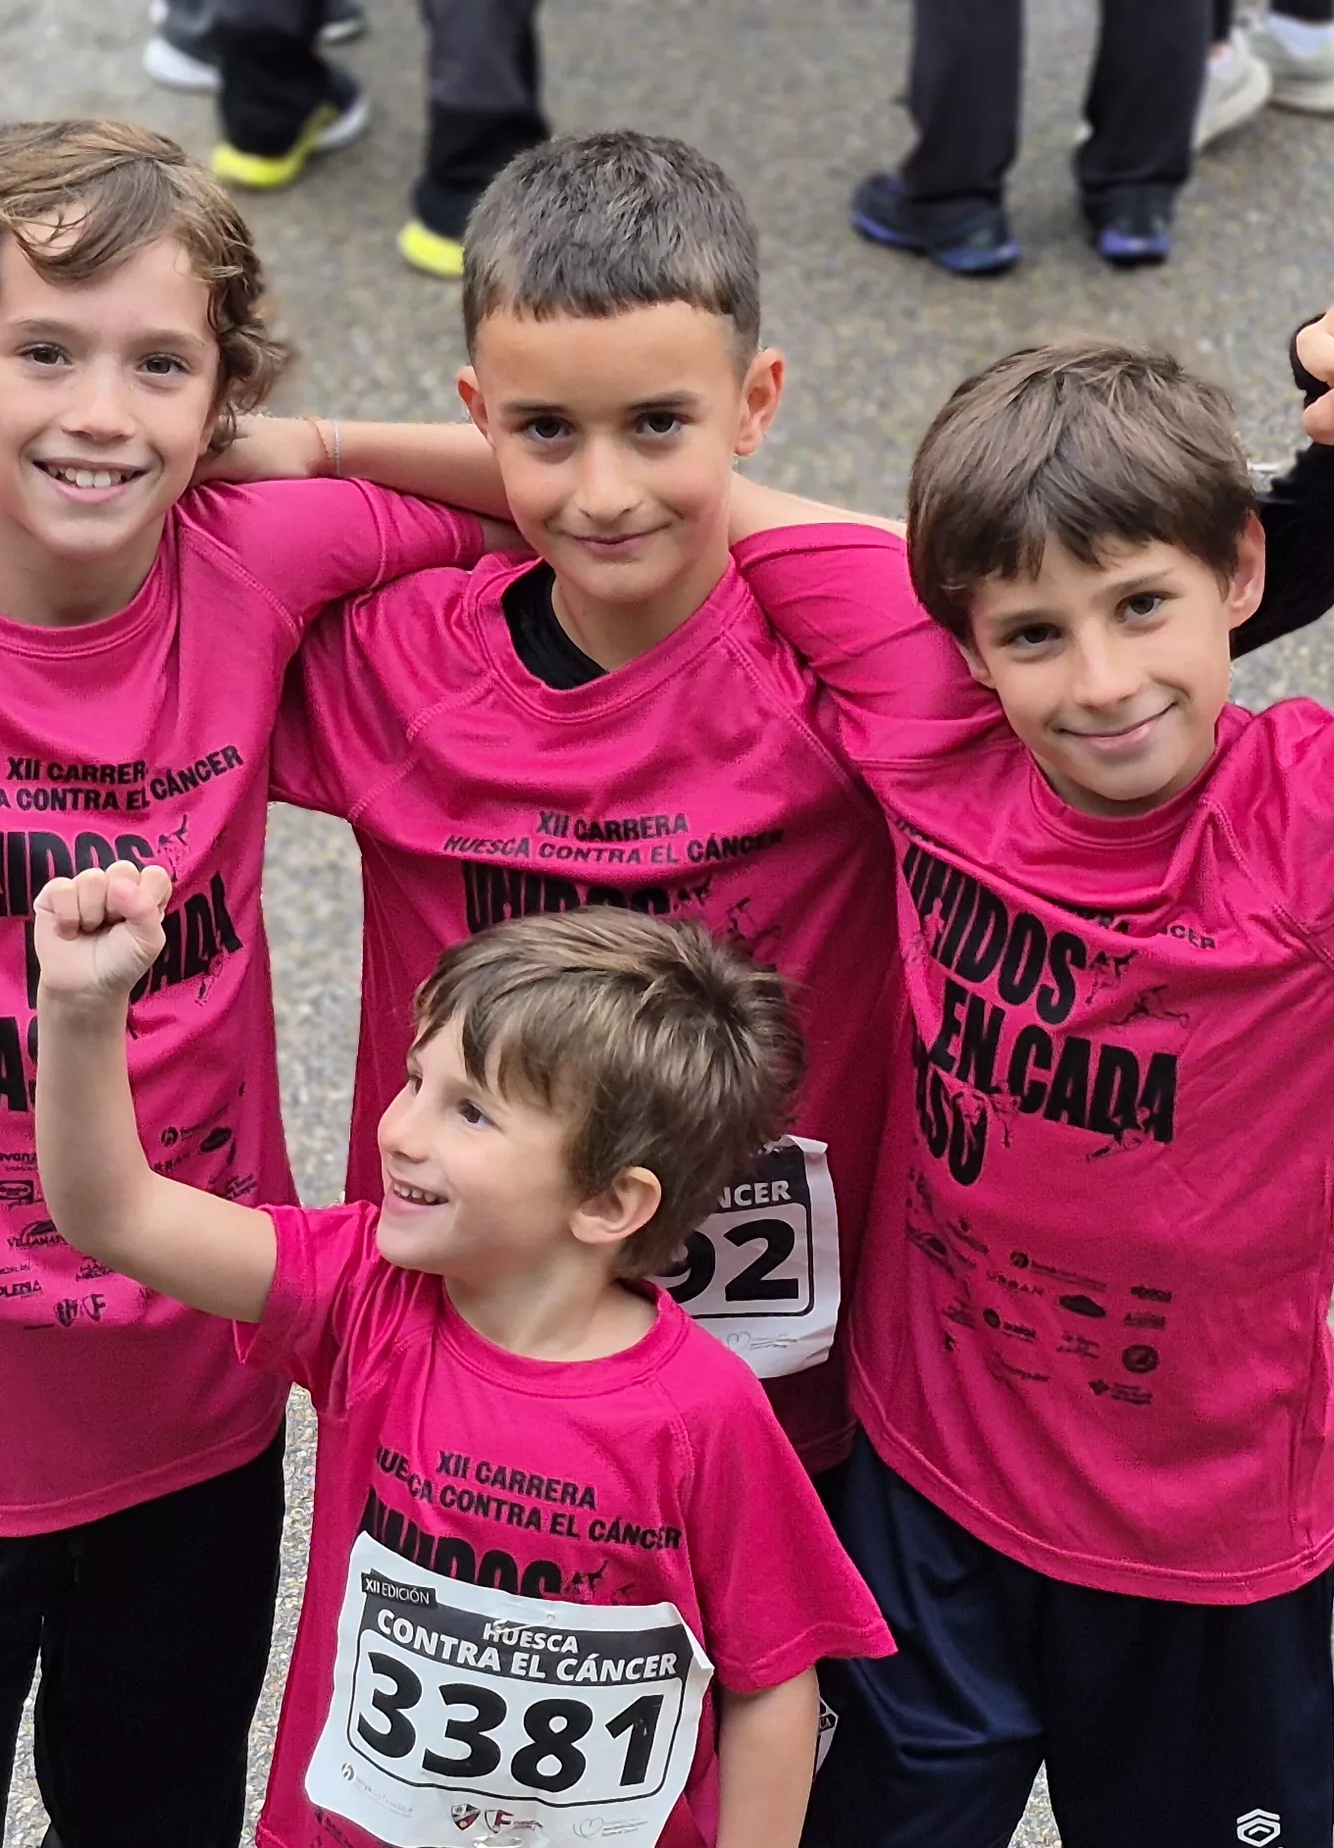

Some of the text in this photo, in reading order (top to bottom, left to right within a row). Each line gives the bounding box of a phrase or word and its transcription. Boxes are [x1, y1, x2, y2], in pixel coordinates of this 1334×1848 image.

[7, 756, 148, 785] XII CARRER
[17, 787, 119, 812] CONTRA
[125, 787, 150, 811] EL
[149, 745, 245, 801] CÁNCER
[443, 834, 531, 858] HUESCA
[539, 842, 641, 864] CONTRA
[650, 845, 680, 865] EL
[535, 811, 689, 842] XII CARRERA
[1008, 1024, 1179, 1144] CADA
[659, 1218, 799, 1304] 92
[437, 1450, 598, 1512] XII CARRERA
[439, 1484, 542, 1533] CONTRA
[549, 1512, 580, 1540] EL
[365, 1578, 430, 1605] XII EDICIÓN
[377, 1608, 677, 1682] CONTRA EL CÁNCER
[483, 1620, 579, 1654] HUESCA
[356, 1651, 665, 1793] 3381
